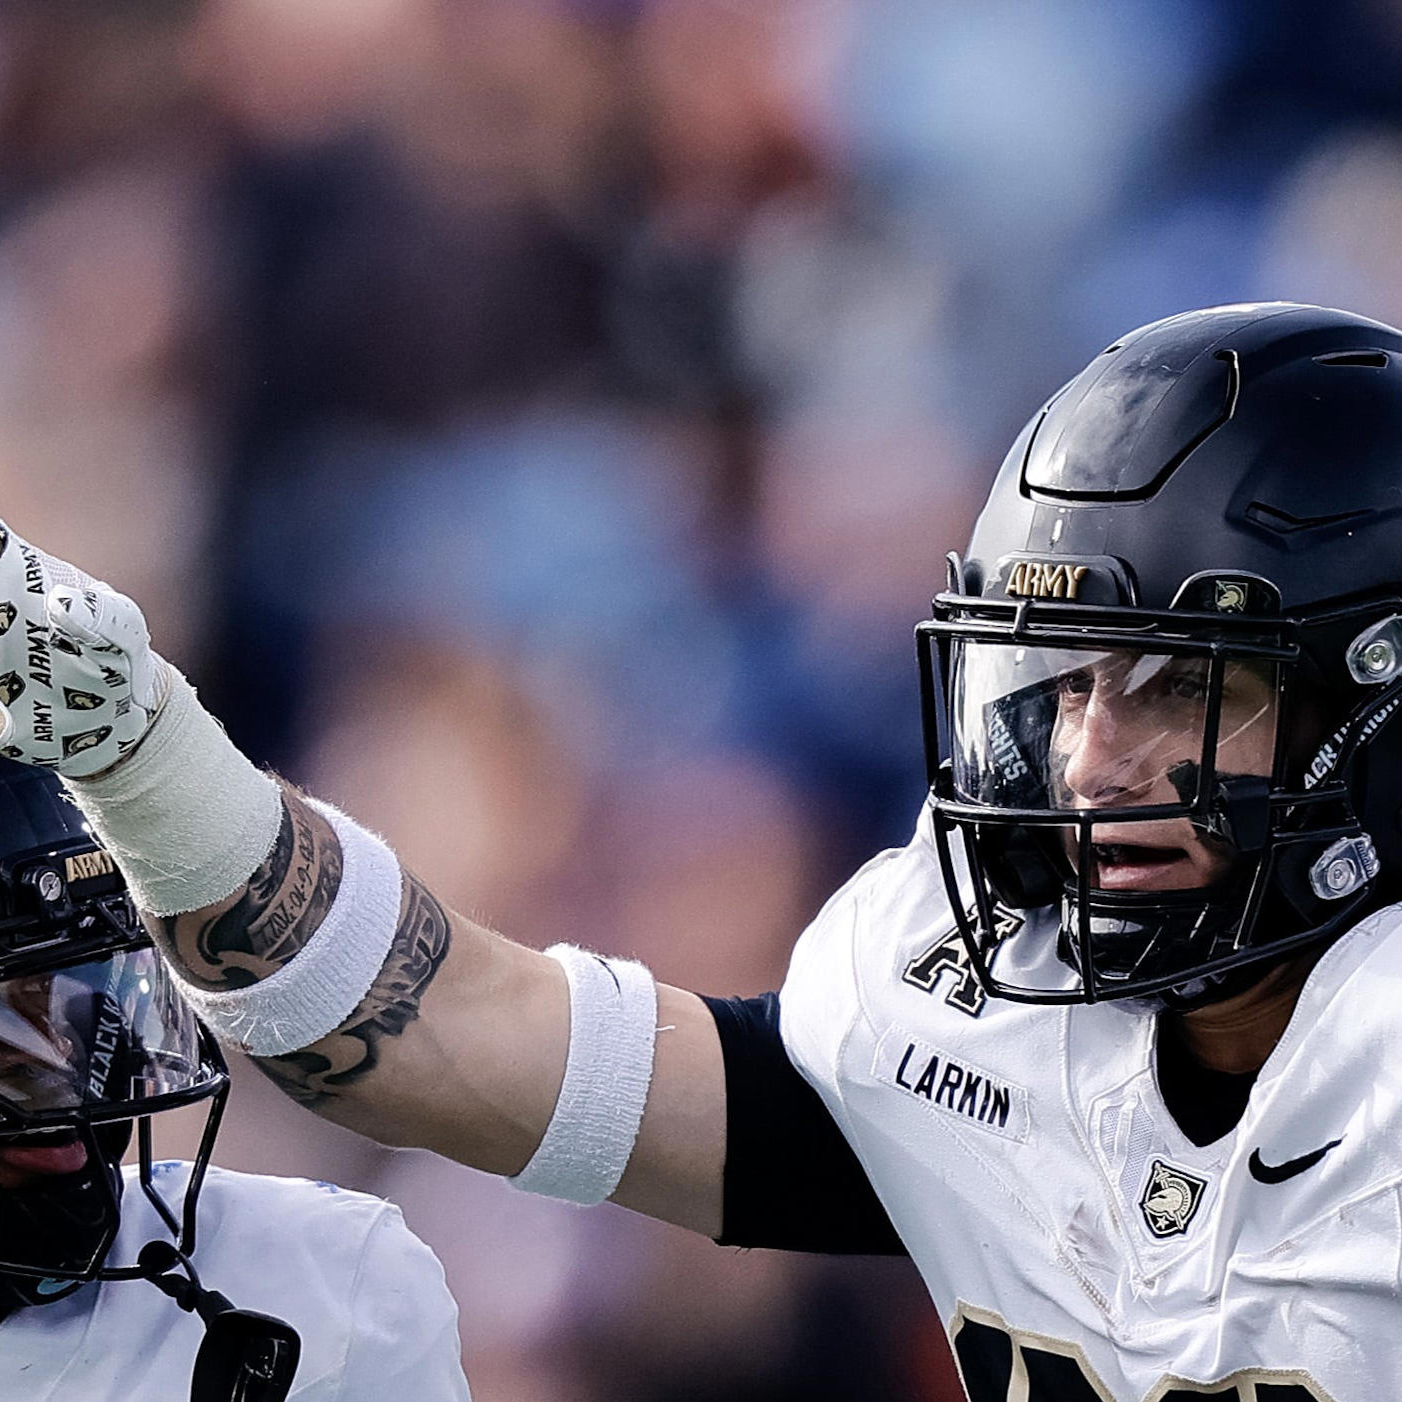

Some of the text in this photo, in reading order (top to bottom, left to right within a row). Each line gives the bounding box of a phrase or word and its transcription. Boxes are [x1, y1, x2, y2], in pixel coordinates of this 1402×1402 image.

[1004, 560, 1089, 599] ARMY
[25, 618, 53, 690] ARMY
[32, 700, 54, 743] ARMY
[88, 1012, 123, 1099] BLACK
[895, 1043, 1011, 1129] LARKIN
